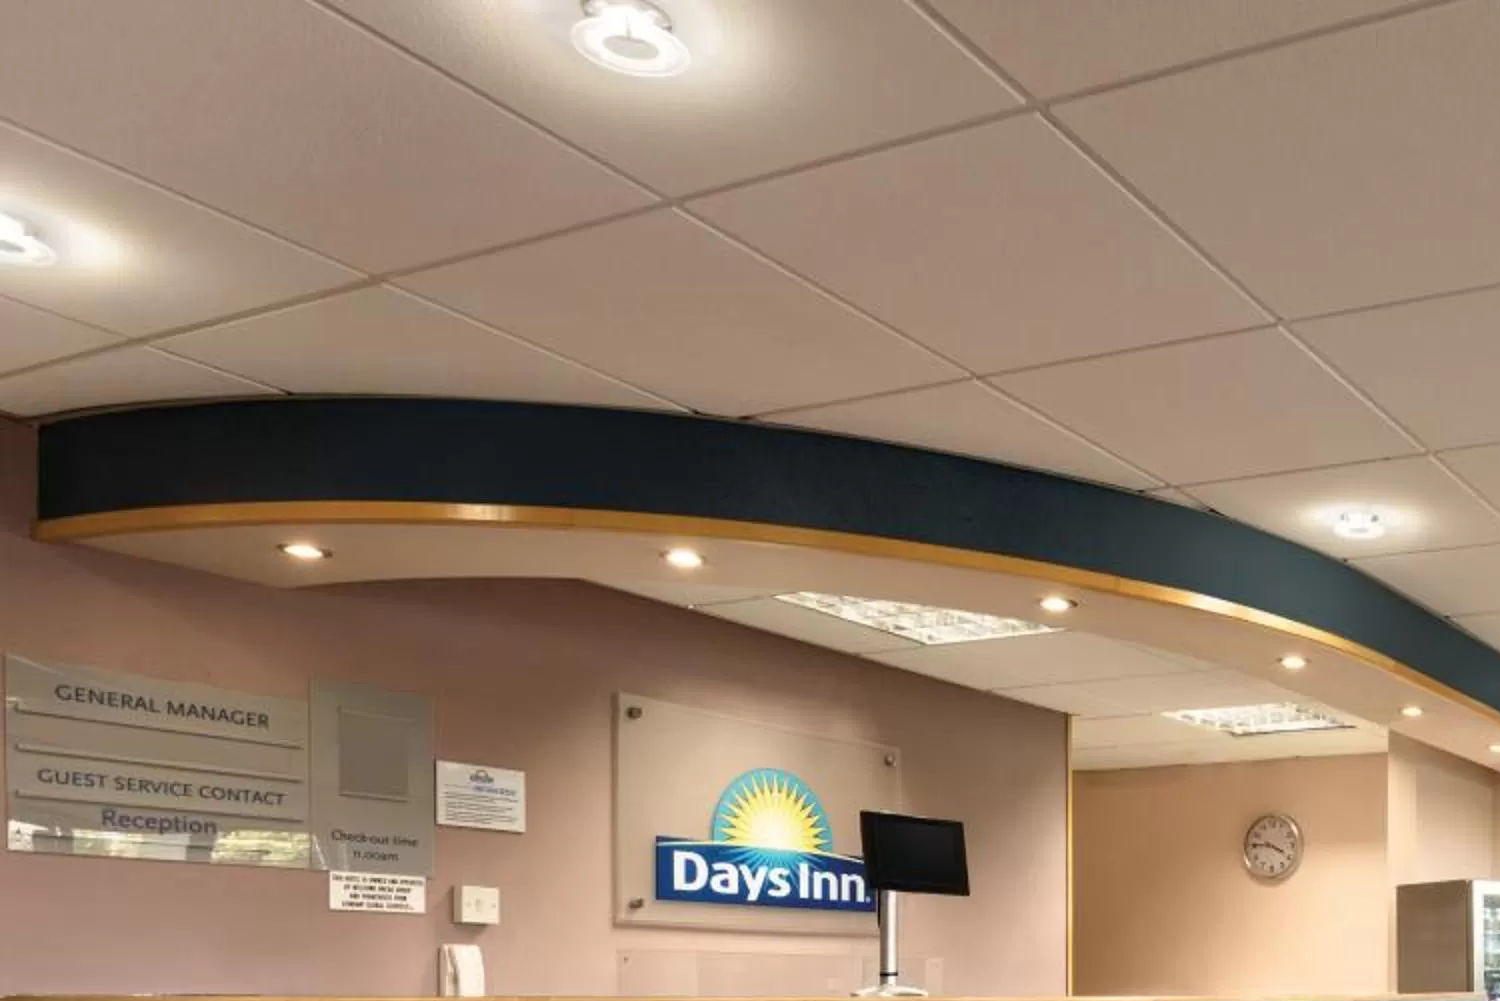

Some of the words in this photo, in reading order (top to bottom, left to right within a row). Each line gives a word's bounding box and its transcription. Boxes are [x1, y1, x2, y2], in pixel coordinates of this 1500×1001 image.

[54, 684, 161, 714] GENERAL
[167, 699, 270, 729] MANAGER
[37, 768, 108, 788] GUEST
[114, 776, 193, 798] SERVICE
[199, 785, 288, 806] CONTACT
[101, 808, 218, 835] Reception
[673, 850, 791, 901] Days
[799, 863, 866, 903] Inn
